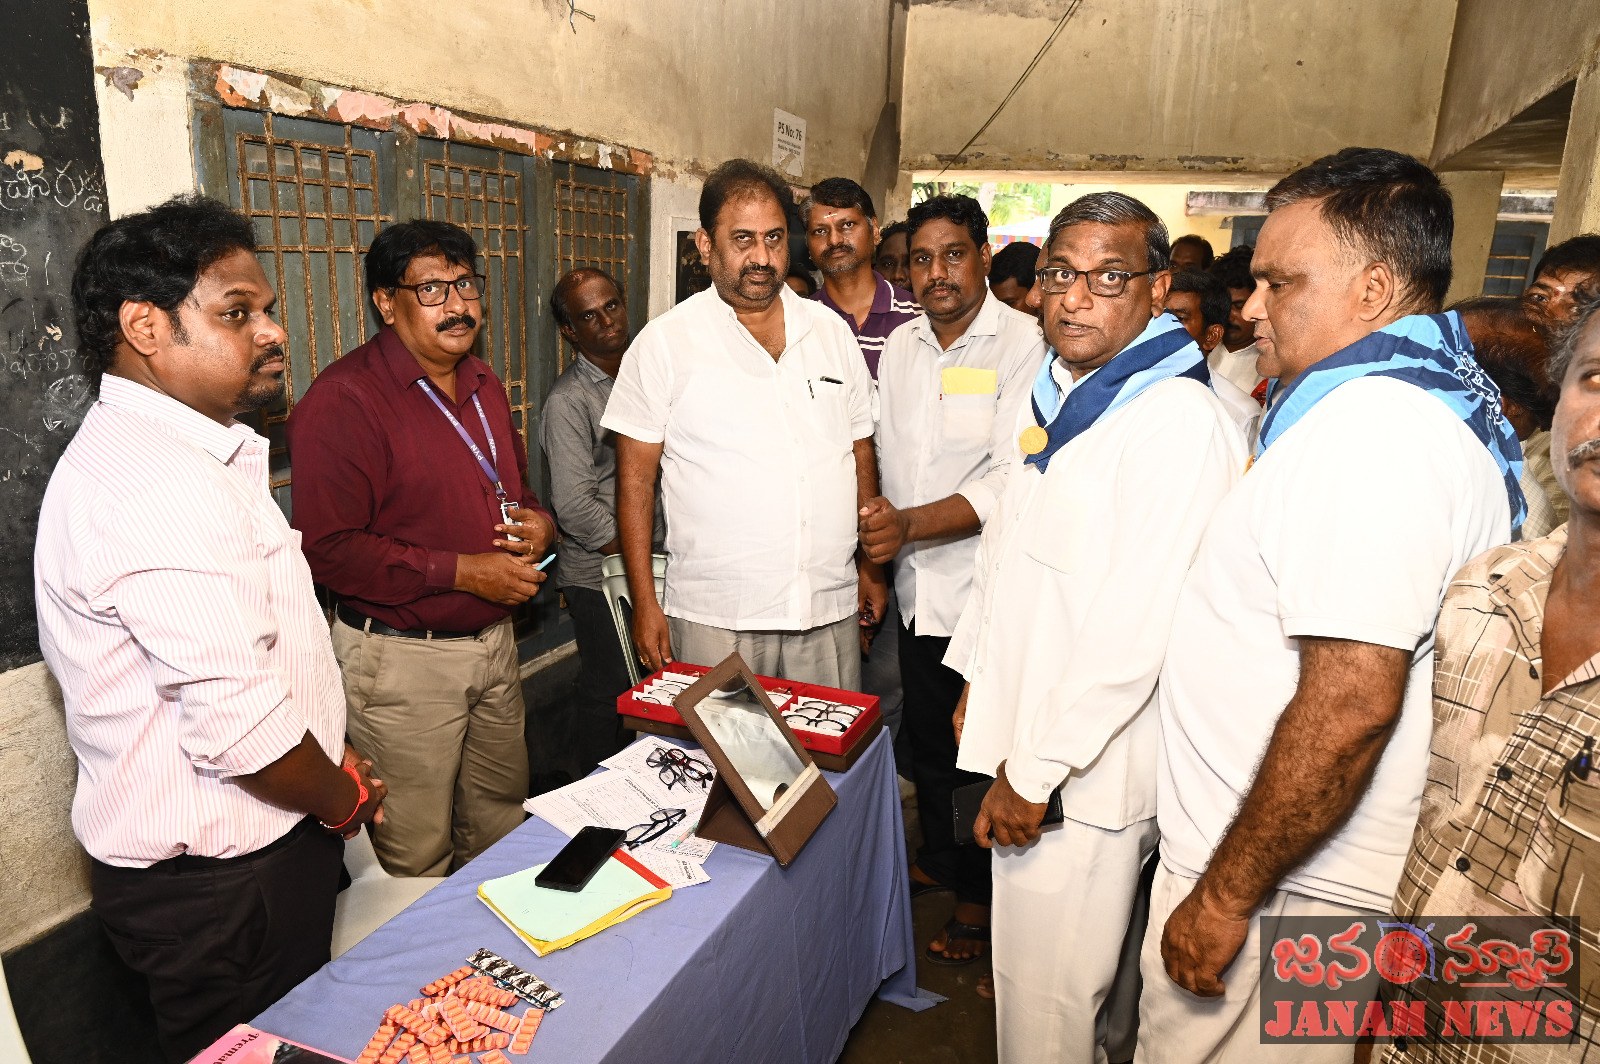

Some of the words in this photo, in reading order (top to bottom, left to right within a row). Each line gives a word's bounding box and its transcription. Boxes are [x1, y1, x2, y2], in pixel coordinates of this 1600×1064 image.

[778, 121, 785, 134] PS
[444, 410, 459, 427] PYN
[470, 444, 484, 461] PYN
[488, 438, 497, 456] PYN
